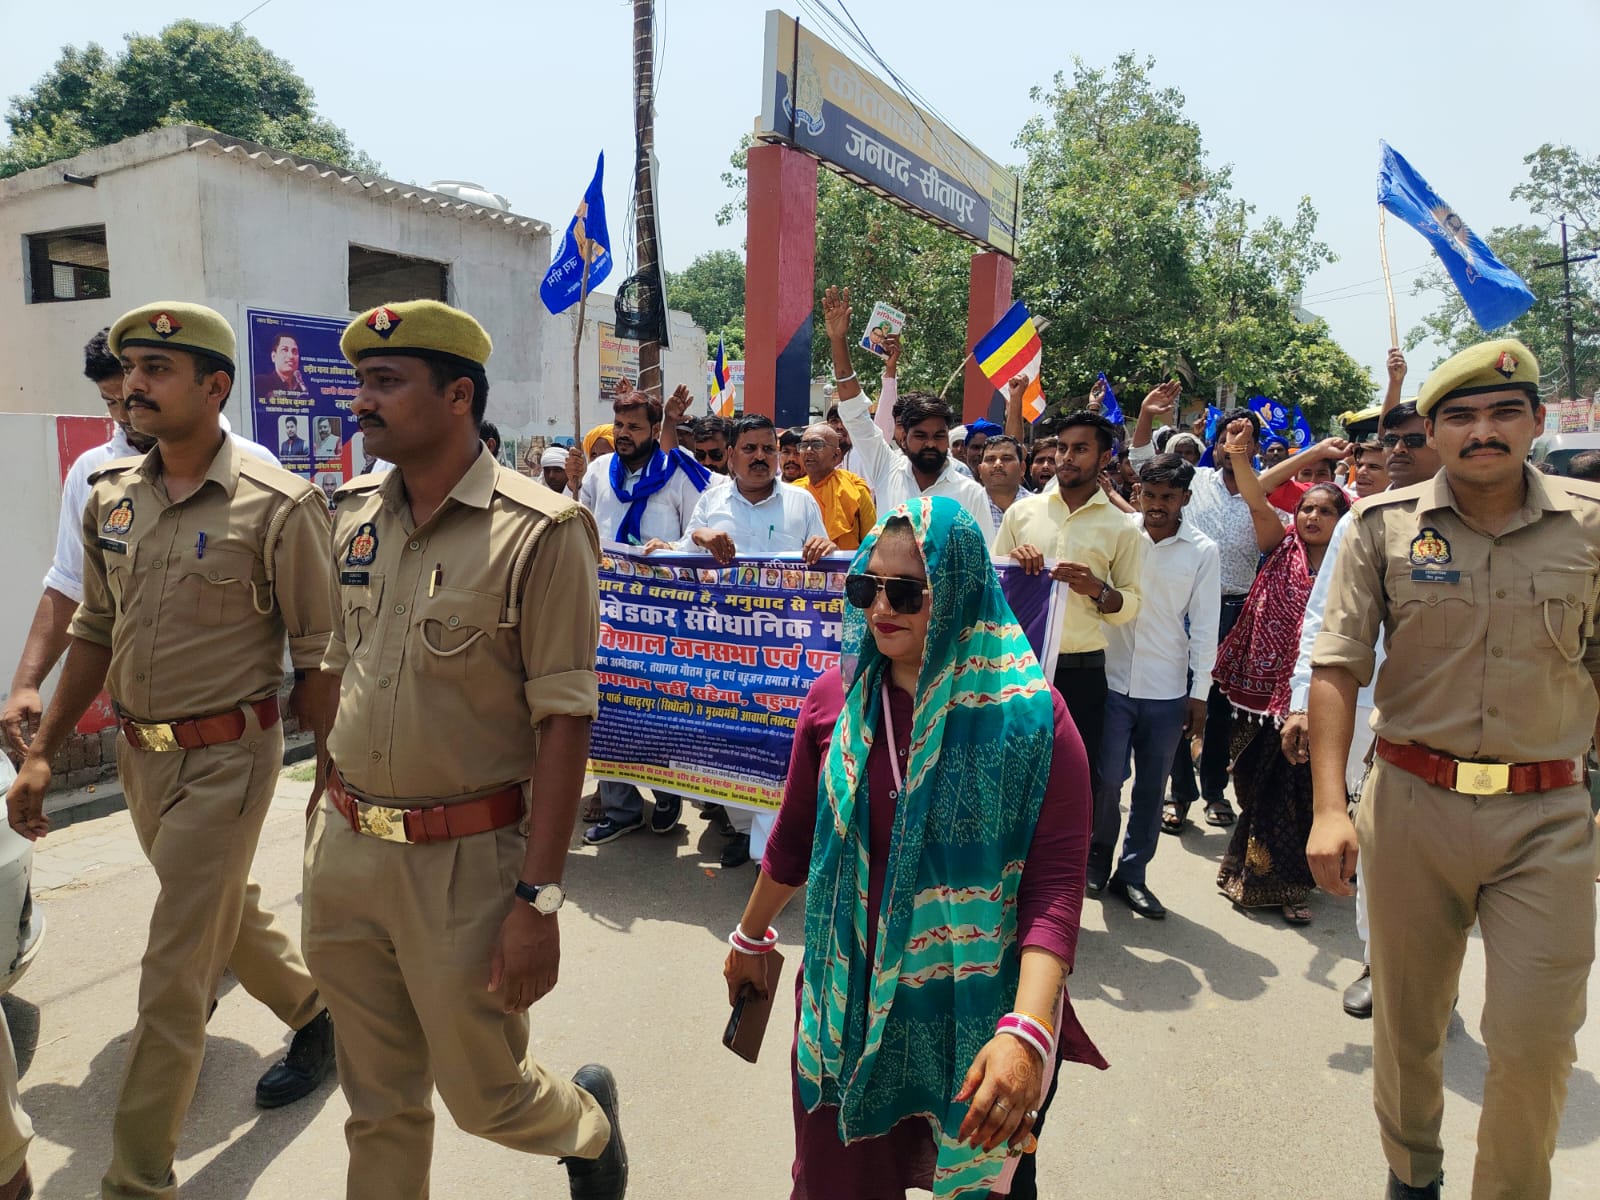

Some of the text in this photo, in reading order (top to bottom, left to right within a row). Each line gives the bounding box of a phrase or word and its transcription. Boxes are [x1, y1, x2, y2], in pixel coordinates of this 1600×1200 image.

[845, 123, 977, 223] जनपद-सीतापुर
[599, 579, 627, 594] धान
[629, 581, 645, 595] से
[649, 586, 698, 602] चलता
[725, 594, 786, 613] मनुवाद
[791, 595, 807, 612] से
[599, 594, 678, 628] म्बेडकर
[684, 605, 813, 640] संवैधानिक
[670, 637, 759, 667] जनसभा
[762, 643, 803, 670] एवं
